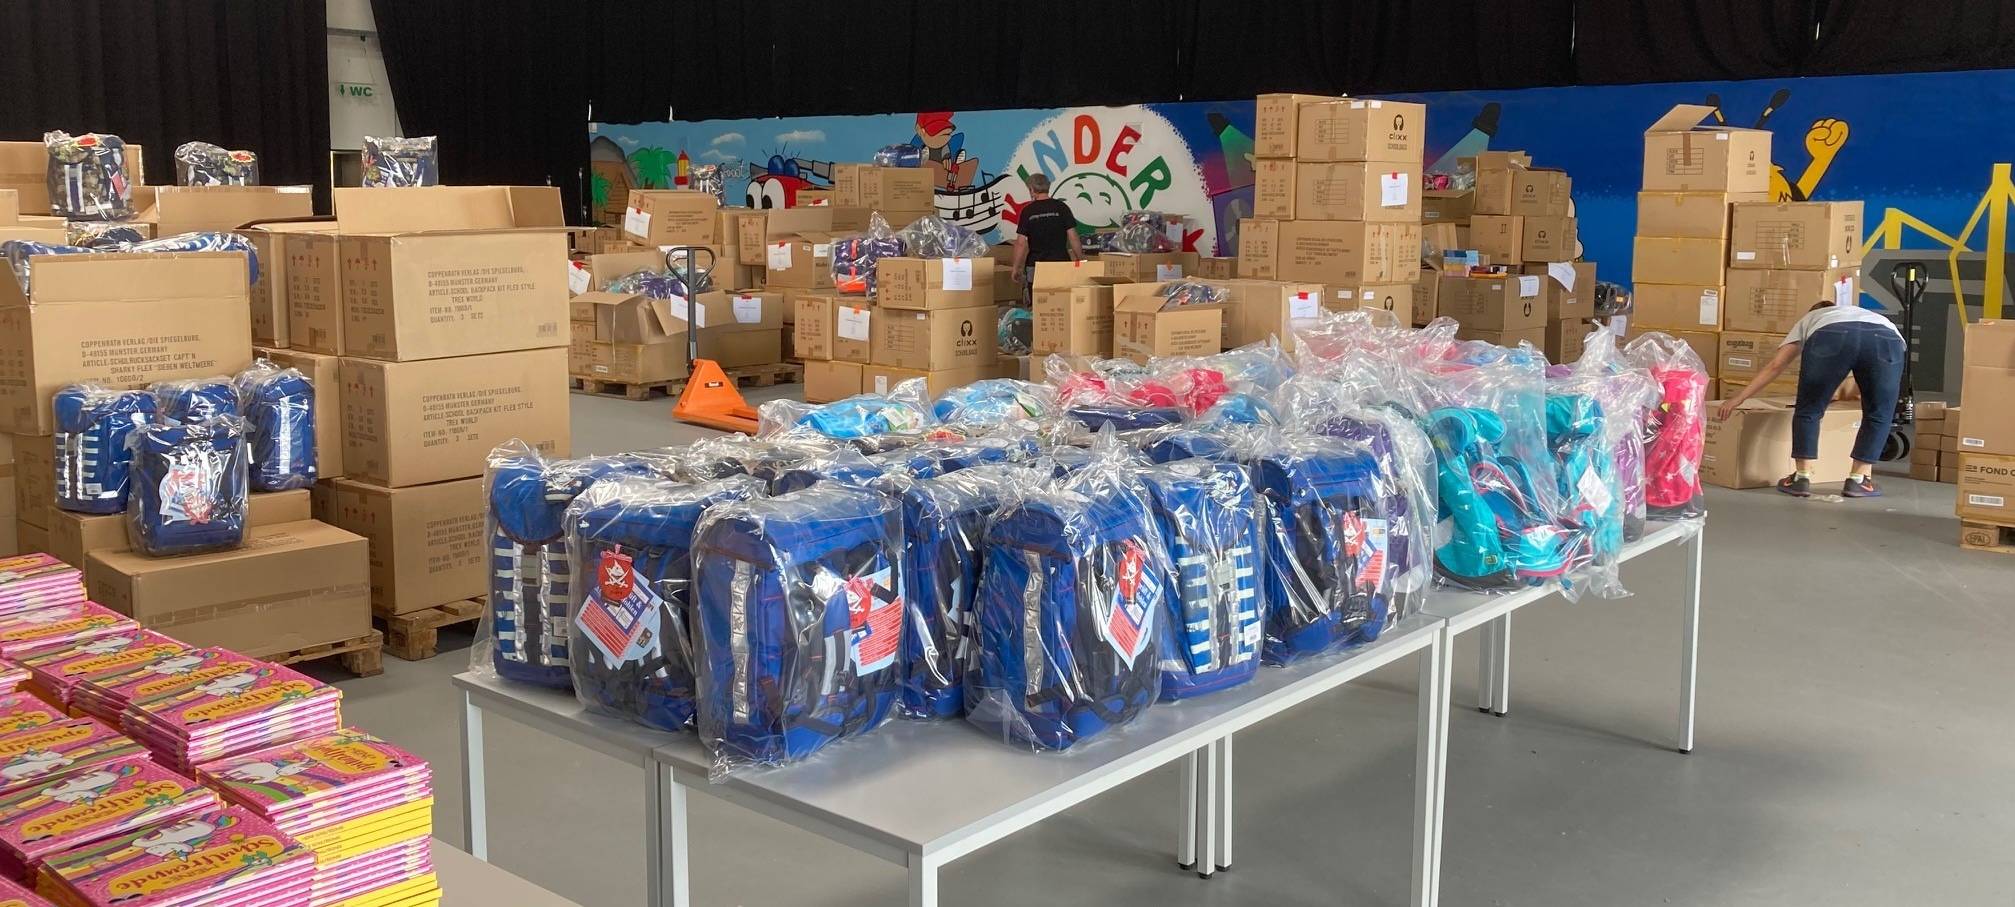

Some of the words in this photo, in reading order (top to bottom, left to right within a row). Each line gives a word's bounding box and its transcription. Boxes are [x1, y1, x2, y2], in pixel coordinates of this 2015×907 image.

[350, 86, 373, 97] WC
[123, 337, 145, 347] VERLAG
[1980, 466, 2008, 476] FOND
